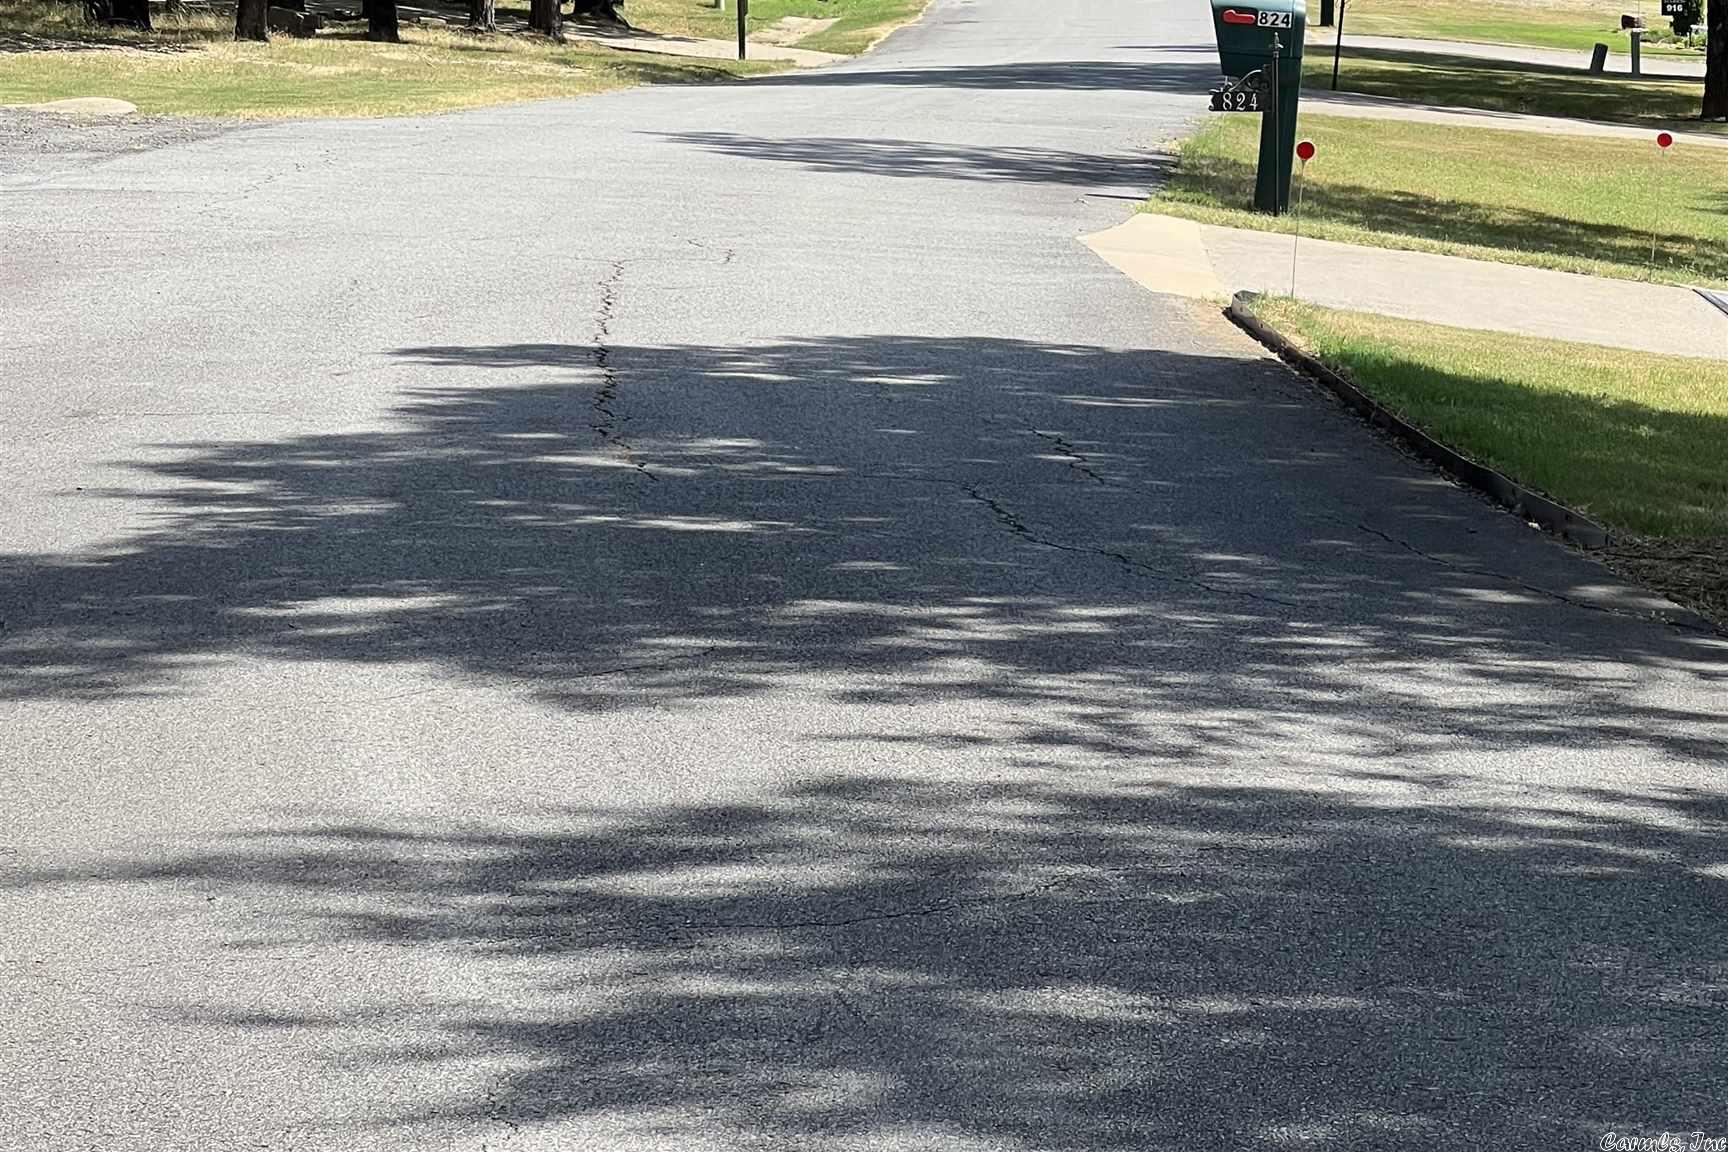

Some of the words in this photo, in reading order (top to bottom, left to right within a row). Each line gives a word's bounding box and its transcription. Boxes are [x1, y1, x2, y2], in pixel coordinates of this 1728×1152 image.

[1666, 4, 1683, 12] 916
[1259, 12, 1290, 27] 824
[1222, 92, 1258, 110] 824
